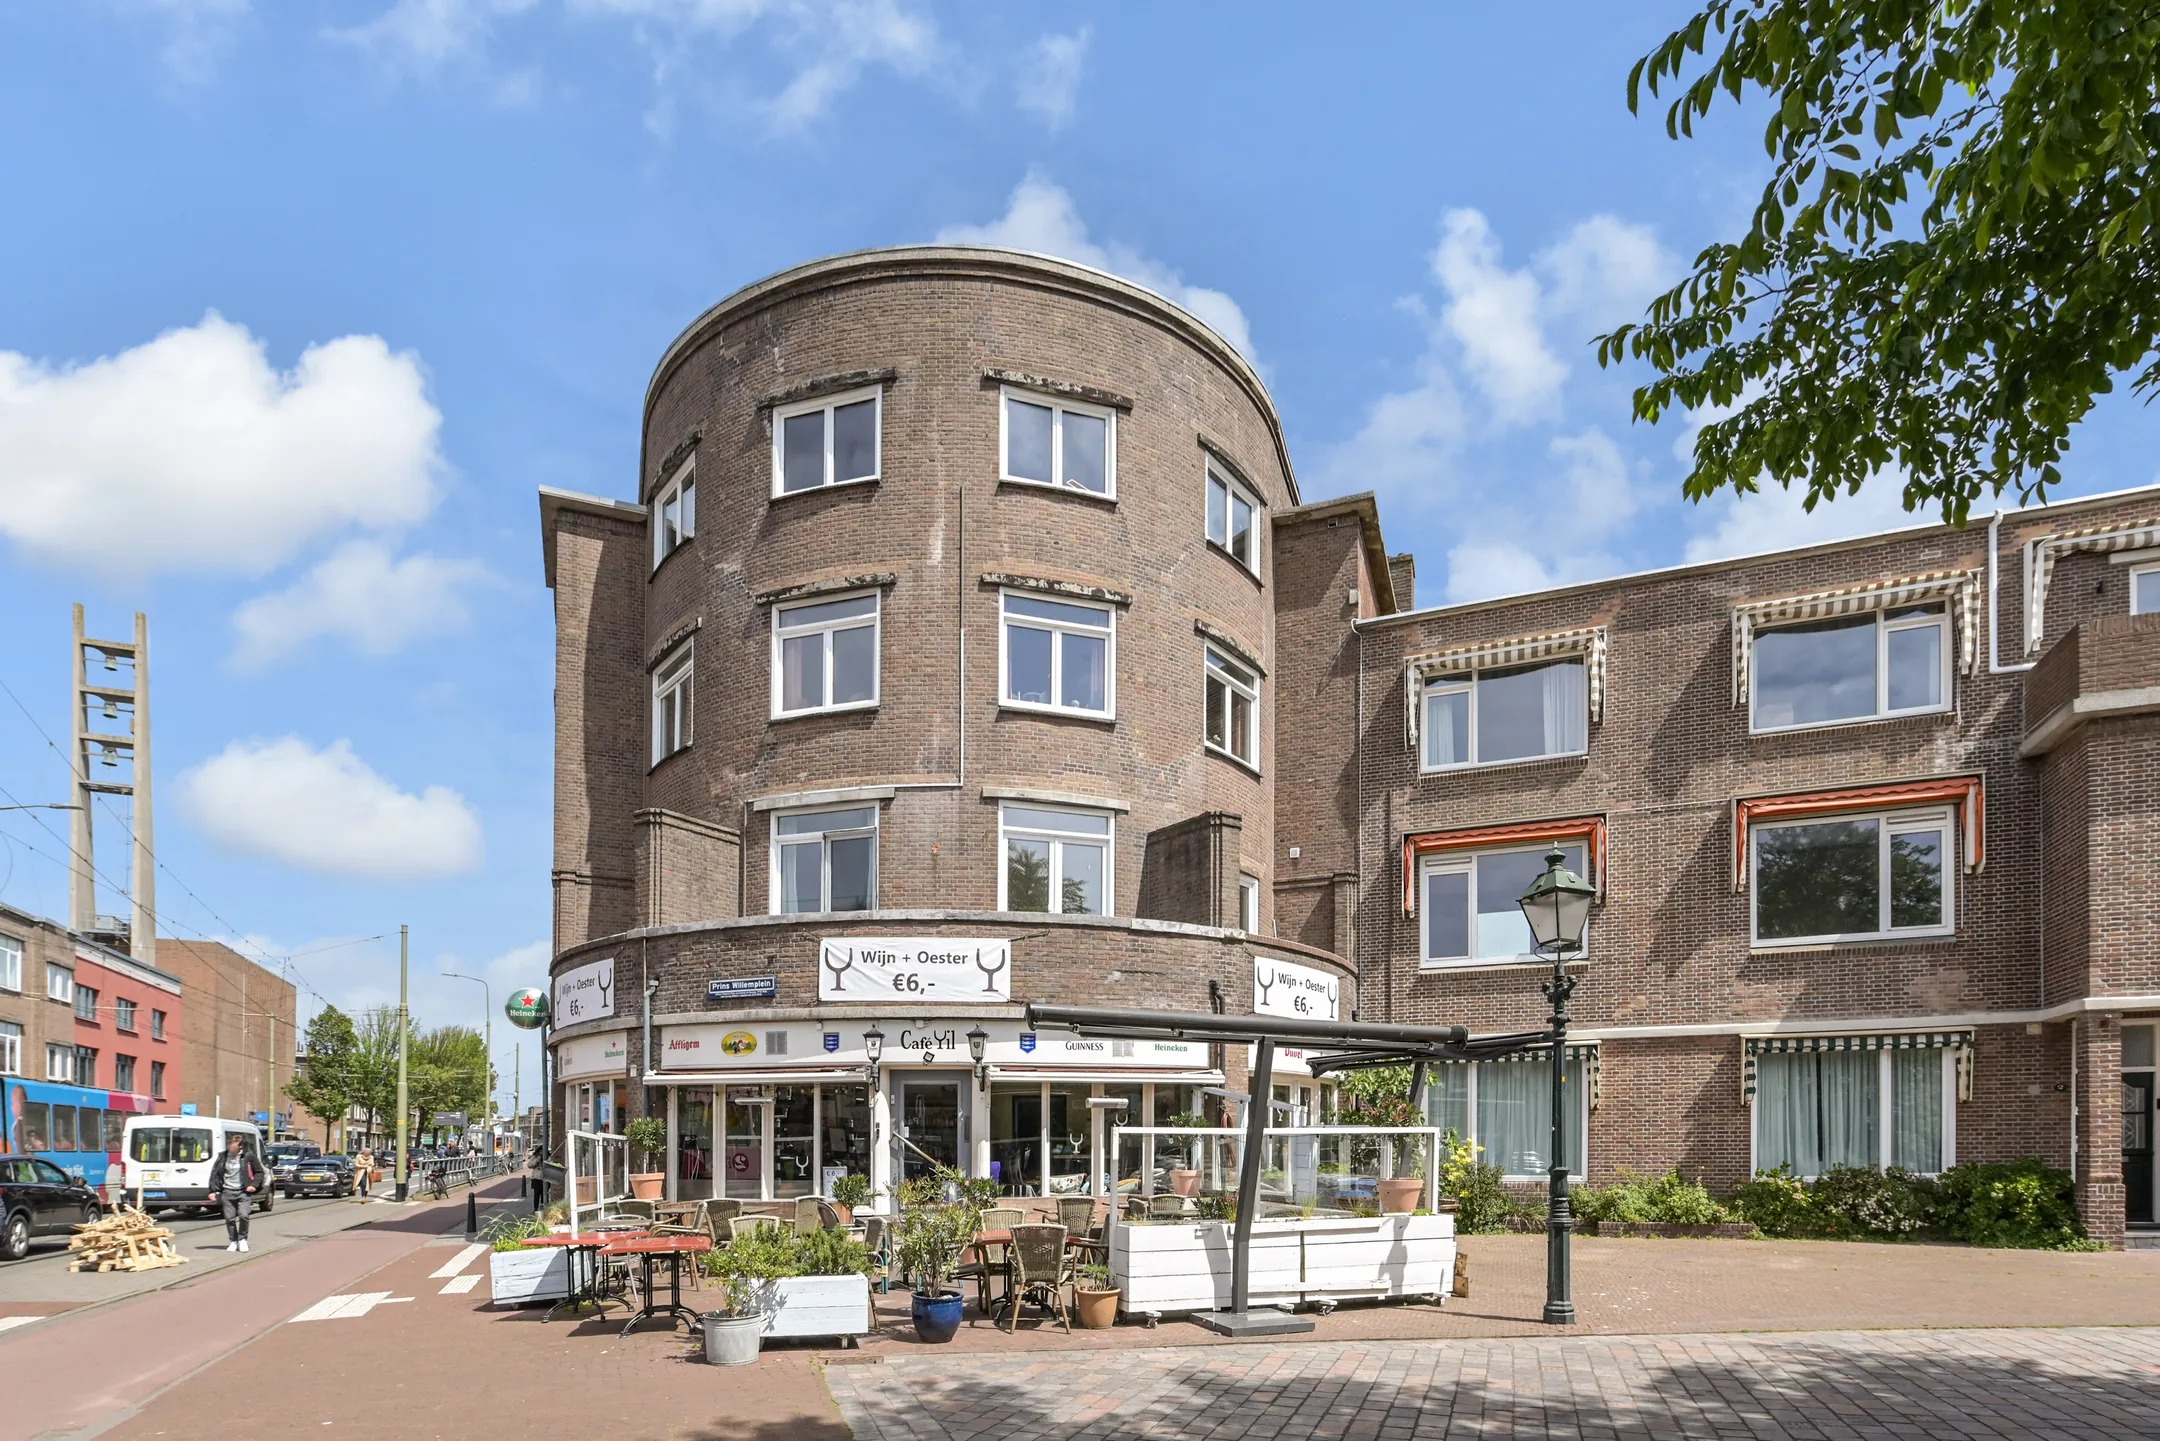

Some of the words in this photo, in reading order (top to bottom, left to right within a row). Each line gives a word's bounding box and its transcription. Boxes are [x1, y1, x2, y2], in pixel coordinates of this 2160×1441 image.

[861, 951, 896, 967] Wijn
[902, 953, 911, 963] +
[917, 951, 968, 964] Oester
[577, 977, 595, 990] Oester
[732, 980, 771, 988] Willemplein
[892, 973, 935, 995] €6,-
[1278, 972, 1297, 989] Wijn
[1305, 978, 1326, 993] Oester
[1294, 996, 1313, 1015] €6,-
[669, 1040, 700, 1050] Affligem
[900, 1030, 932, 1049] Café
[934, 1030, 955, 1049] Yil
[1065, 1041, 1104, 1051] GUINNESS
[1154, 1044, 1188, 1052] Heineken
[1284, 1047, 1303, 1059] Duvel
